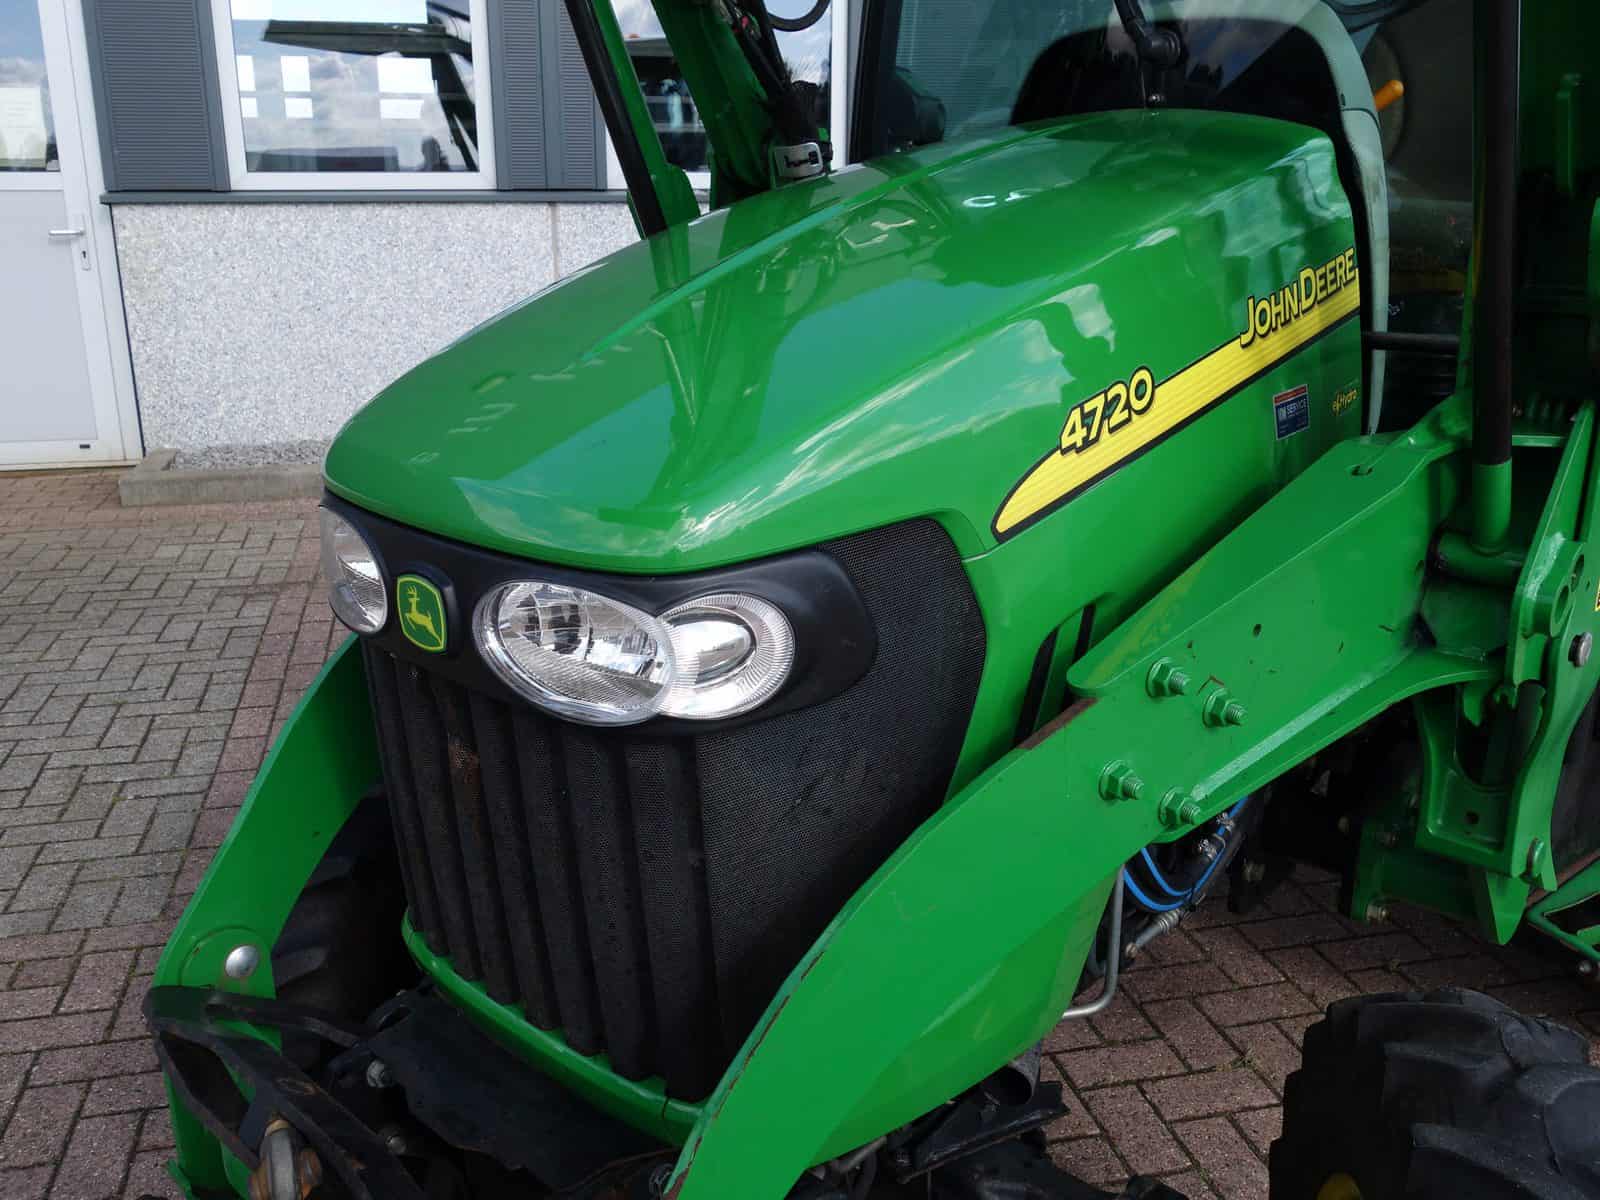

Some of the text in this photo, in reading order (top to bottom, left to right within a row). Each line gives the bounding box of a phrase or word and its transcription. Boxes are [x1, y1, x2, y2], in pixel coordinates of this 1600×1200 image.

[1240, 247, 1356, 348] JOHN DEERE
[1060, 366, 1154, 454] 4720
